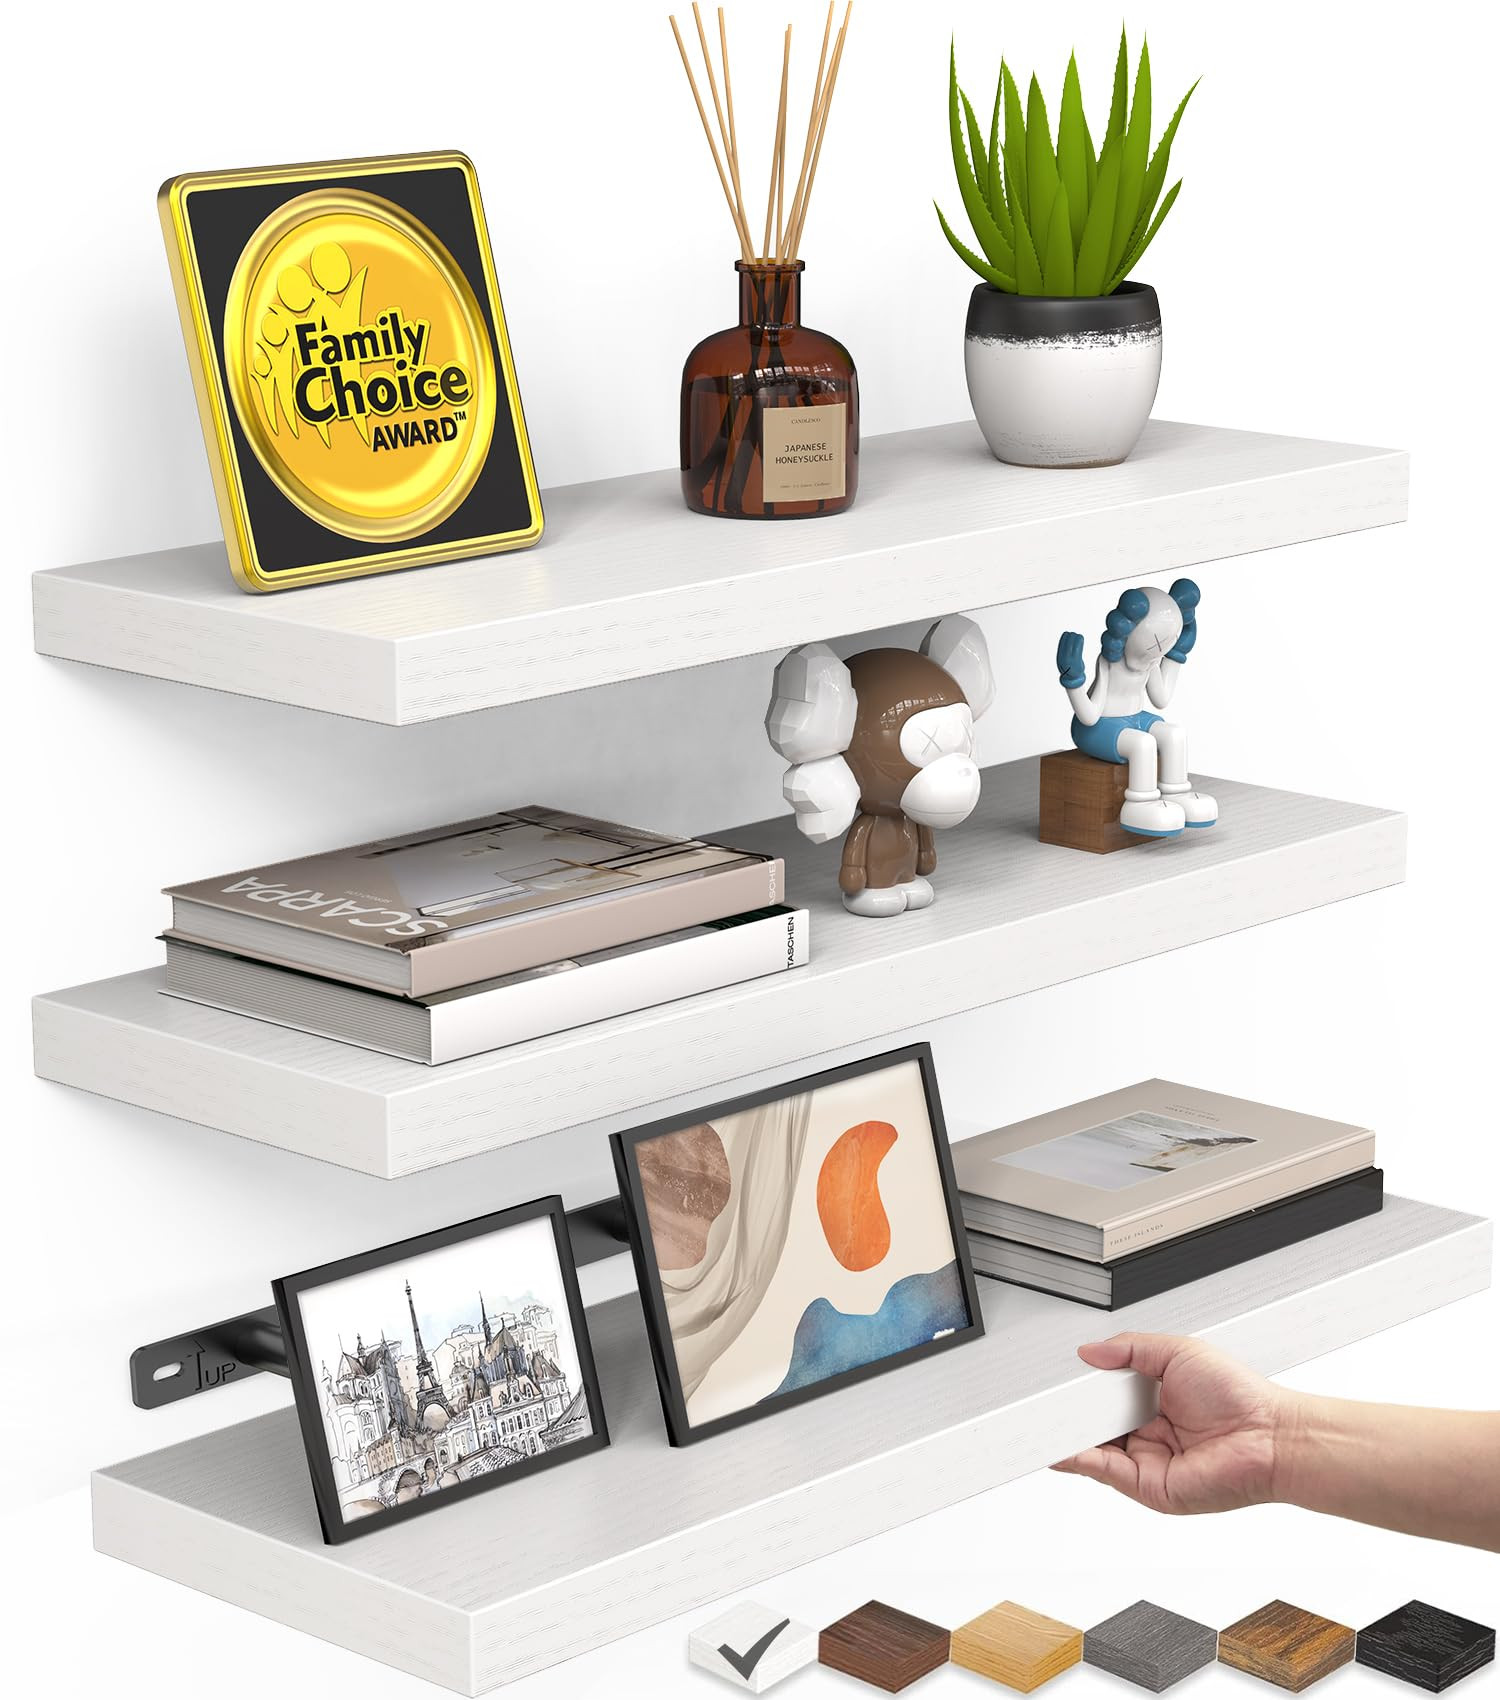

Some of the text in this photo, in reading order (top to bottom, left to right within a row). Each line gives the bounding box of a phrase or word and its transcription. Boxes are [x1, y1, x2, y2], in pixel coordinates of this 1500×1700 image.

[295, 312, 426, 366] Family
[295, 358, 469, 423] Choice
[775, 453, 833, 465] HONEYSUCKLE
[784, 442, 827, 453] JAPANESE
[220, 876, 449, 936] SCARPA
[787, 916, 795, 968] TASCHEN
[205, 1362, 236, 1385] UP
